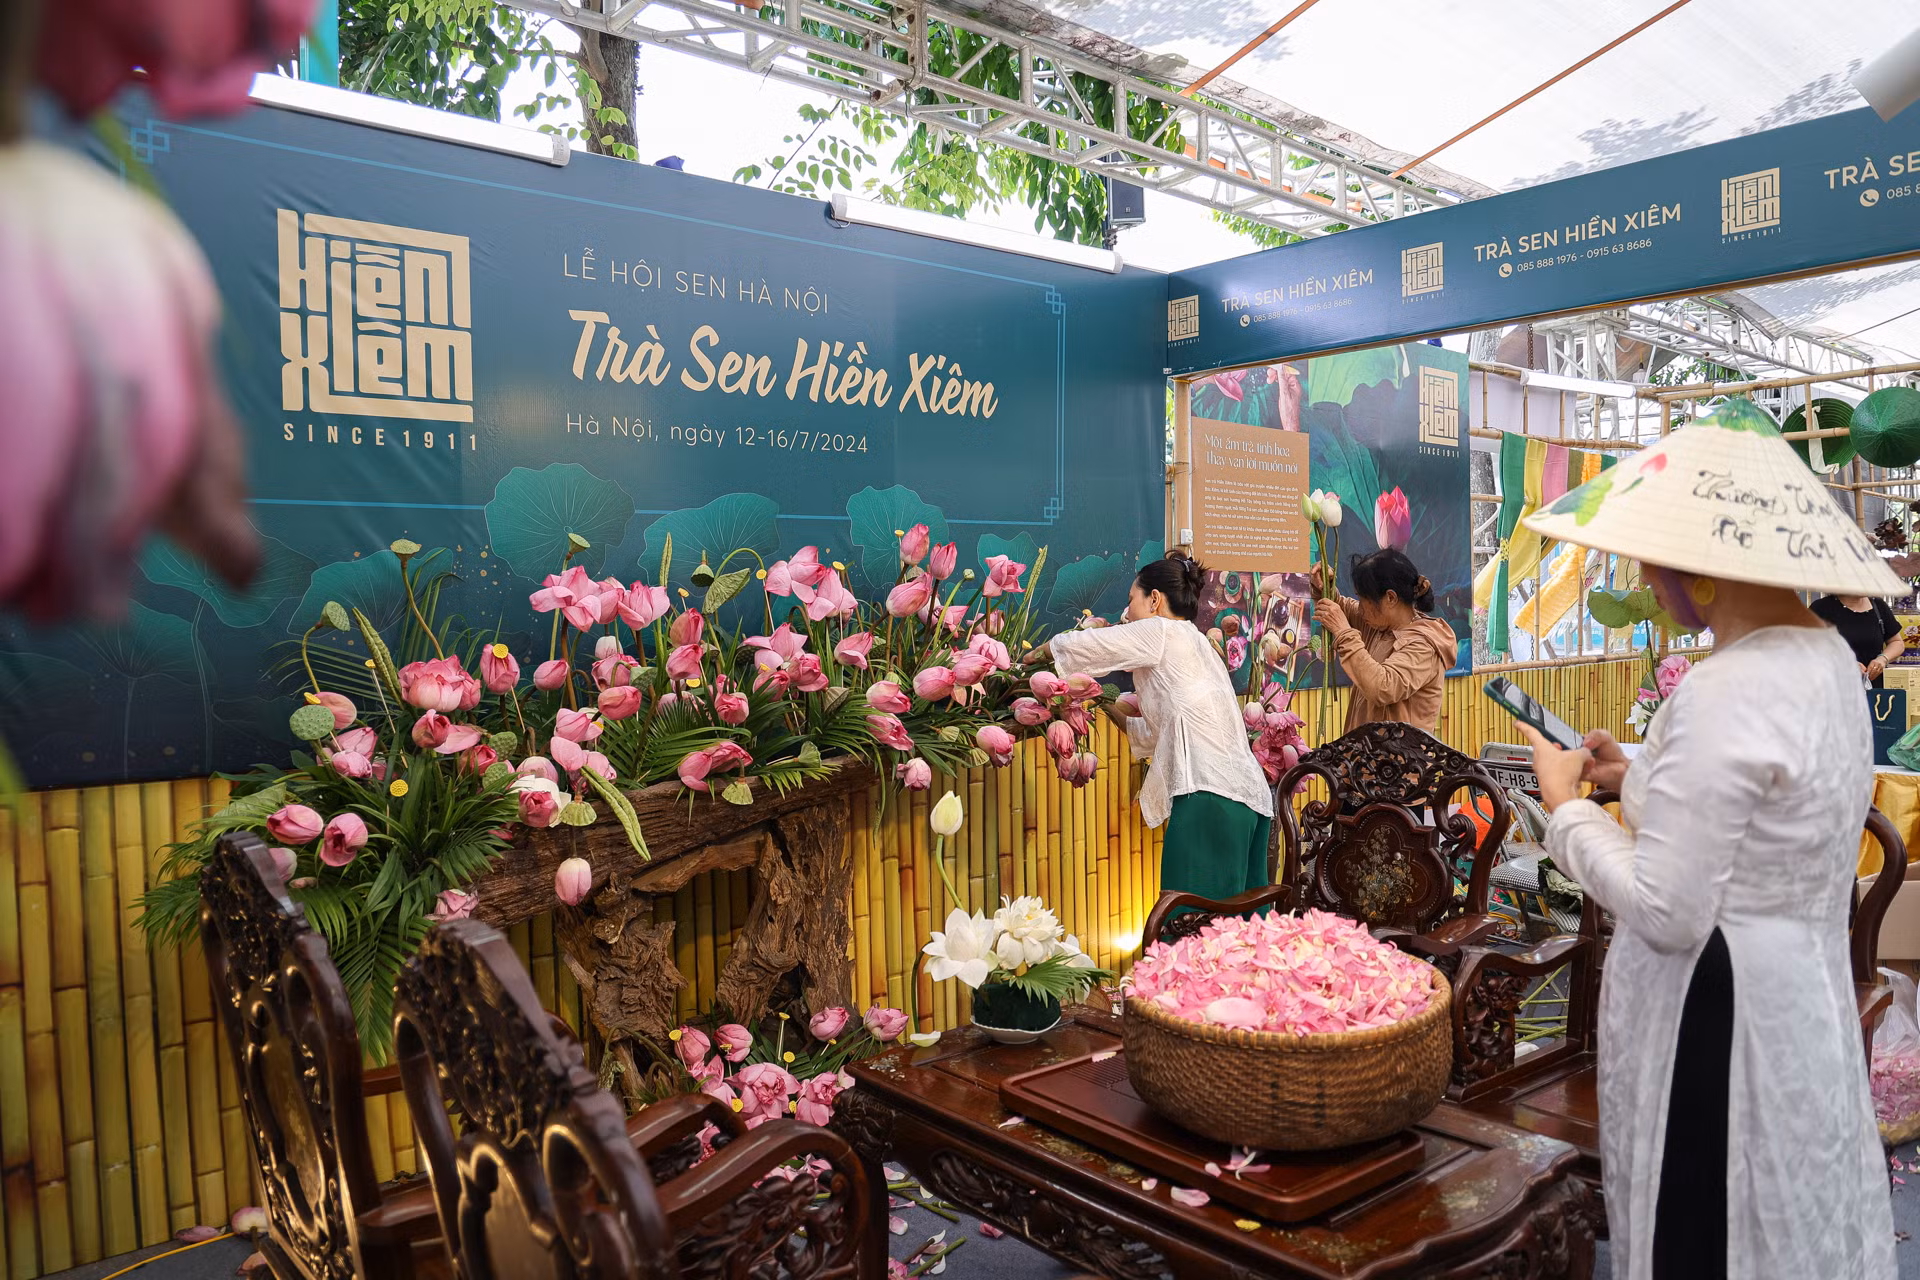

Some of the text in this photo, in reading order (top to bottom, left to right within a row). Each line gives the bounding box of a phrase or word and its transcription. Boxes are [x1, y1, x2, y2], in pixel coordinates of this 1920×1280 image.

[1824, 157, 1880, 190] TRÀ
[1886, 185, 1912, 200] 085
[1473, 203, 1681, 262] TRÀ SEN HIỀN XIÊM
[1721, 227, 1781, 244] SINCE 1911
[1517, 261, 1535, 273] 085
[1537, 258, 1554, 269] 888
[1557, 252, 1578, 265] 1976
[1586, 247, 1609, 259] 0915
[1612, 243, 1624, 254] 63
[1626, 238, 1652, 251] 8686
[563, 246, 829, 317] LỄ HỘI SEN HÀ NỘI
[1221, 268, 1374, 313] TRÀ SEN HIỀN XIÊM
[1253, 313, 1267, 323] 085
[1268, 311, 1281, 320] 888
[1282, 308, 1298, 318] 1976
[1304, 304, 1322, 313] 0915
[1323, 301, 1332, 310] 63
[1333, 298, 1353, 308] 8686
[568, 309, 998, 419] Trà Sen Hiền Xiêm
[283, 423, 476, 451] SINCE 1911
[566, 413, 868, 454] Hà Nội, ngày 12-16/7/2024
[1205, 433, 1222, 450] Một
[1274, 442, 1290, 457] hoa
[1419, 446, 1460, 458] SINCE 1911
